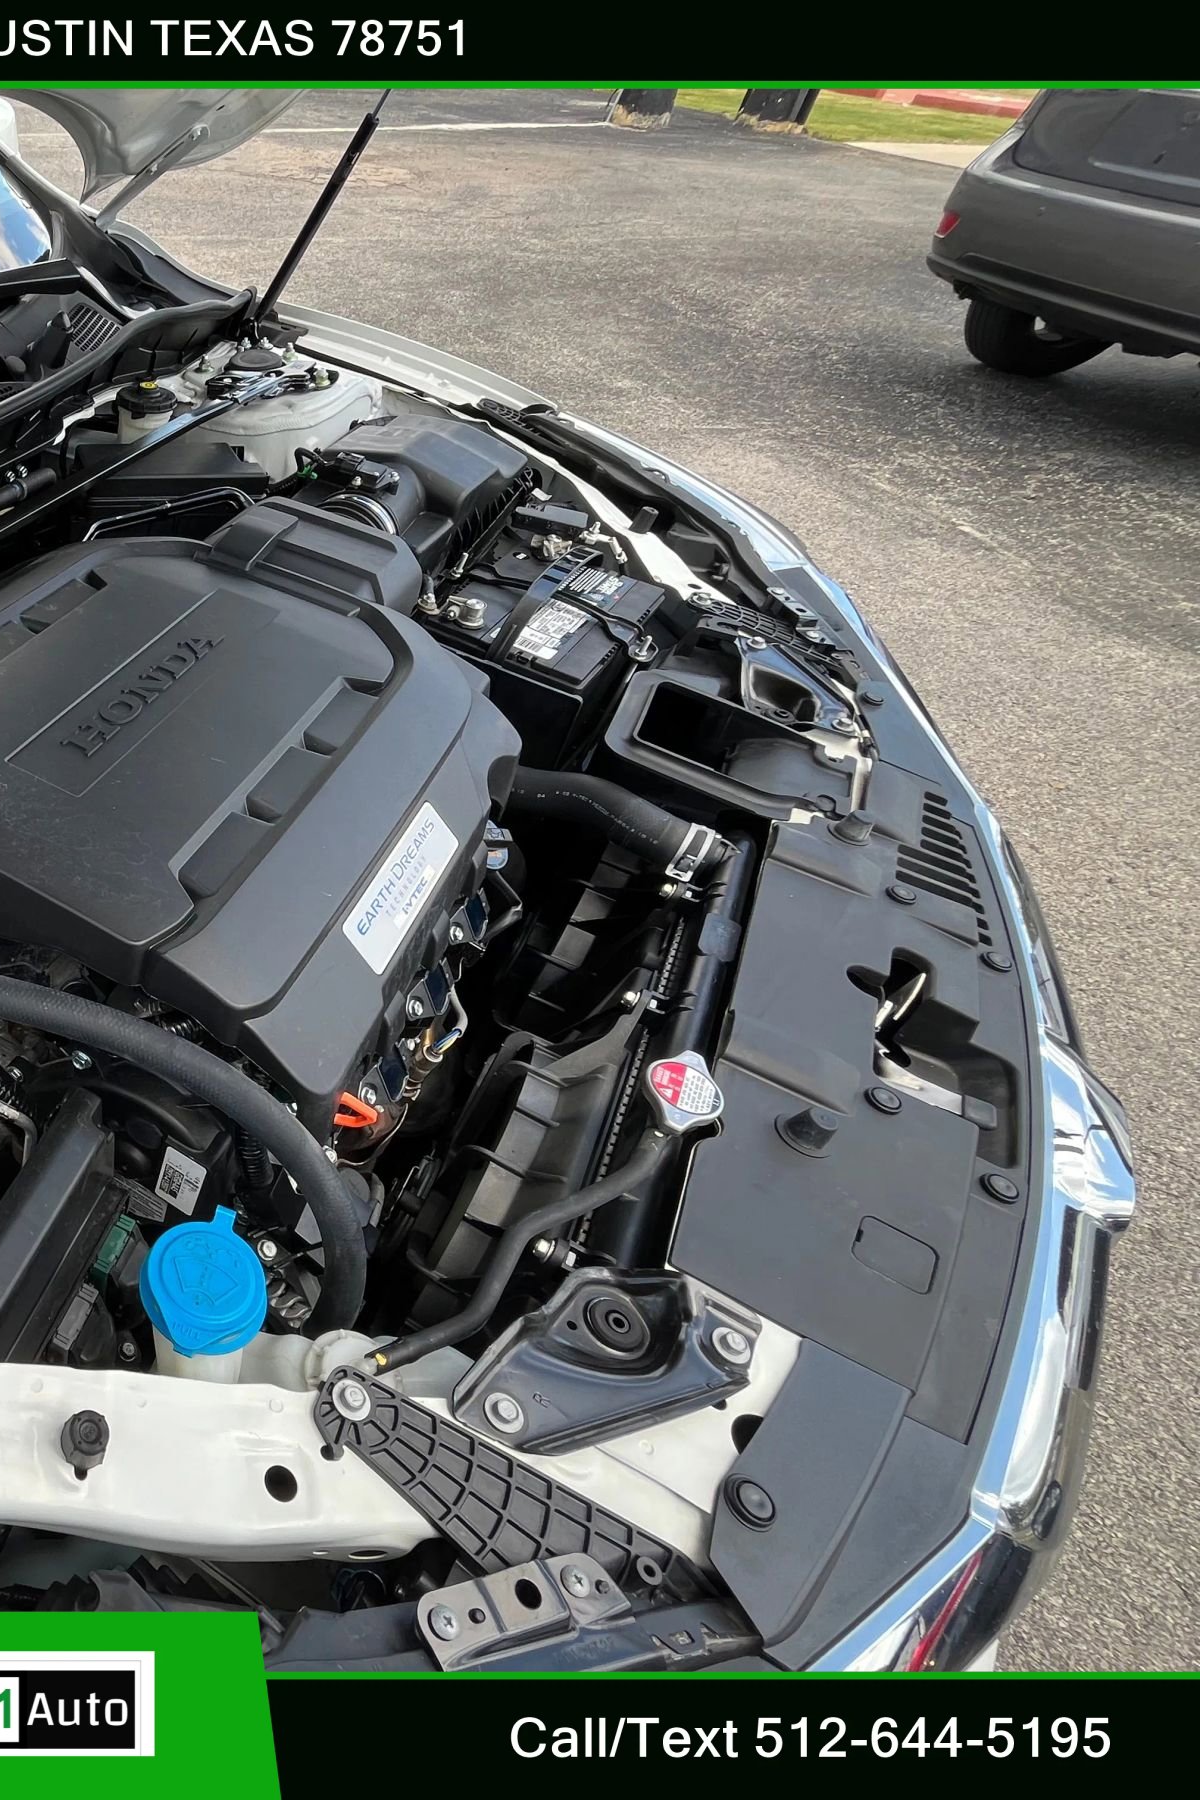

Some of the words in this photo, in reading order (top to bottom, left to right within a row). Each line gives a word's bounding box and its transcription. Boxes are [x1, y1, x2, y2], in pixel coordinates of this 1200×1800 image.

[59, 634, 226, 757] HONDA
[357, 878, 396, 936] EARTH
[390, 818, 435, 881] DREAMS
